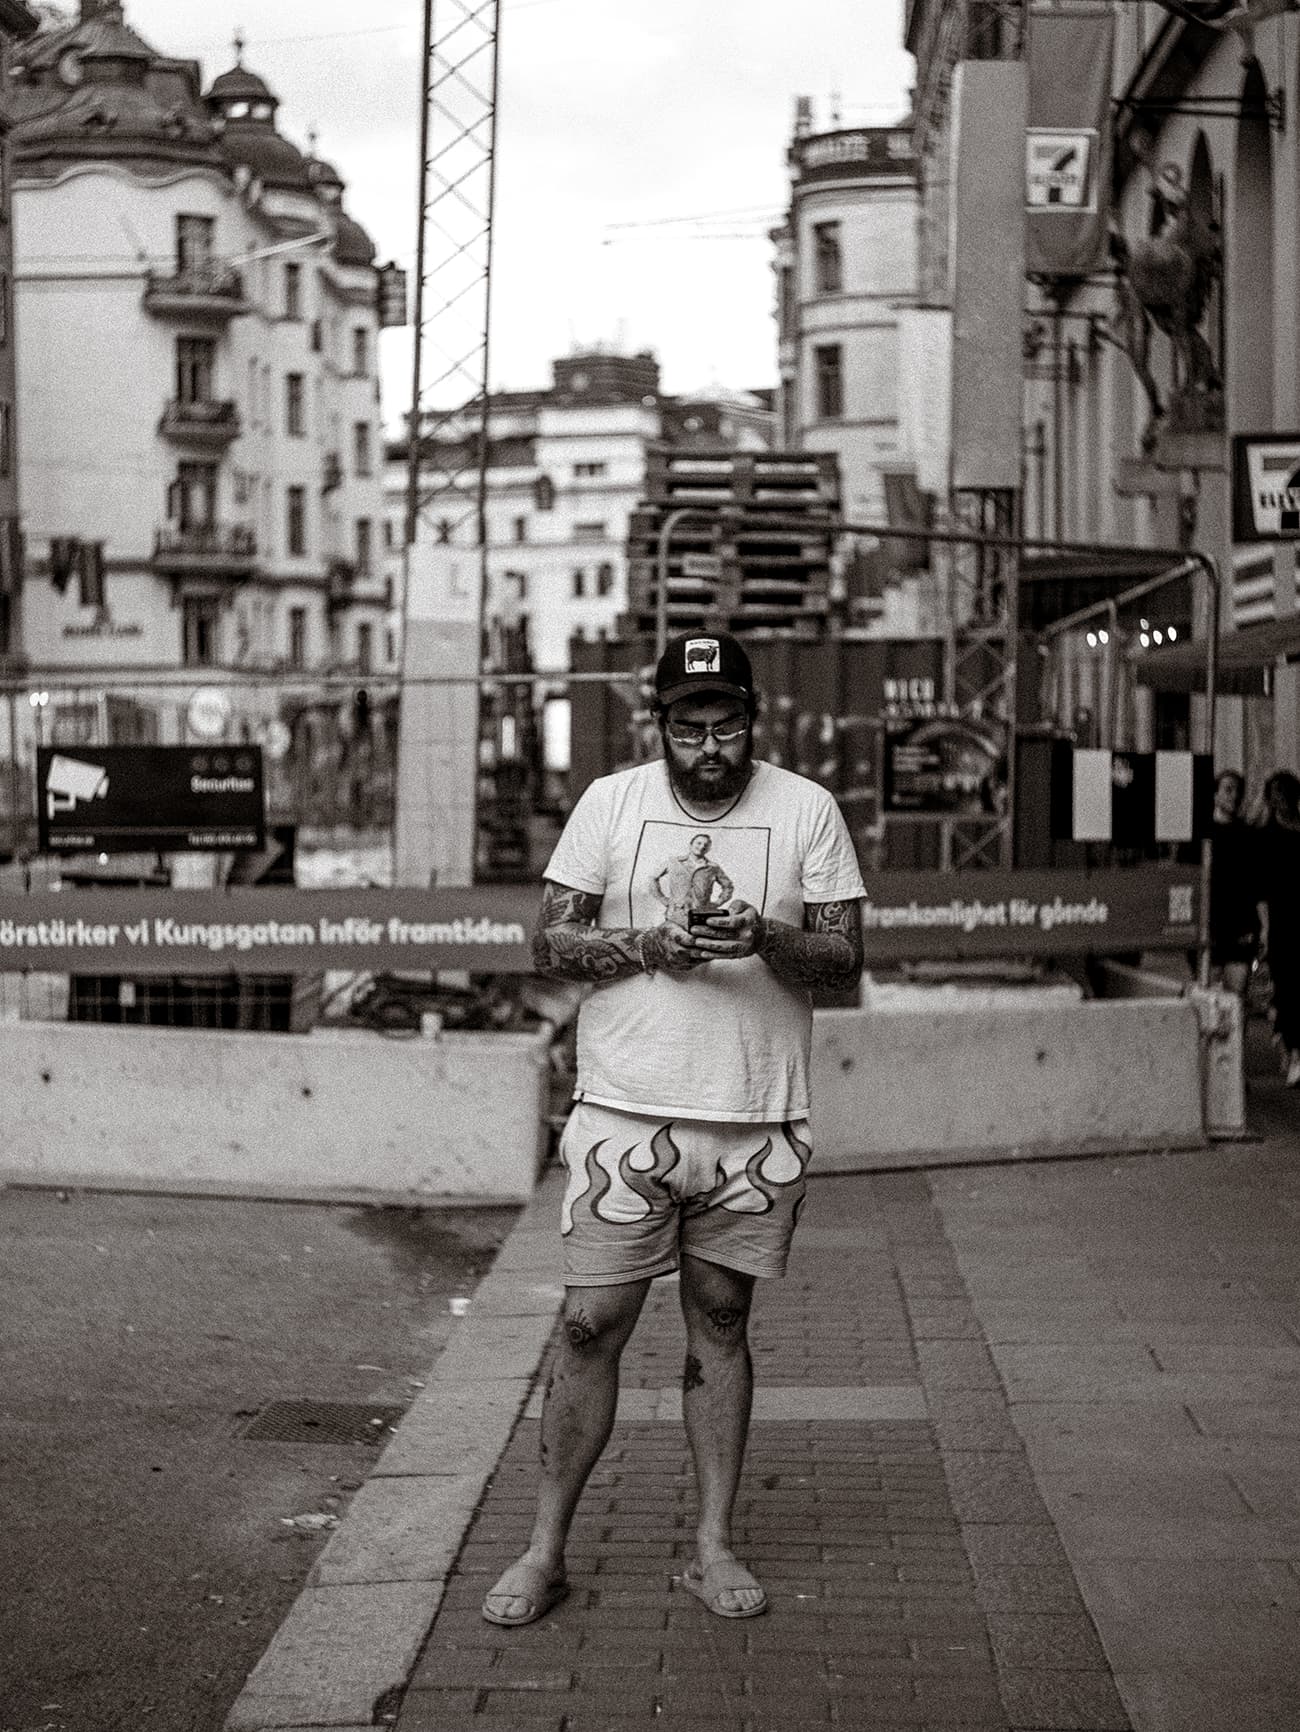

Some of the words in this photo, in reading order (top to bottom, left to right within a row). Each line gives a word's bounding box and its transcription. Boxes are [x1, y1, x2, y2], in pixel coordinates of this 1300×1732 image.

[190, 775, 255, 793] Securitas
[1009, 898, 1037, 925] för
[1040, 895, 1109, 932] gående
[0, 918, 120, 947] örstärker
[126, 918, 148, 945] vi
[156, 918, 314, 951] Kungsgatan
[319, 917, 382, 944] inför
[388, 916, 525, 944] framtiden
